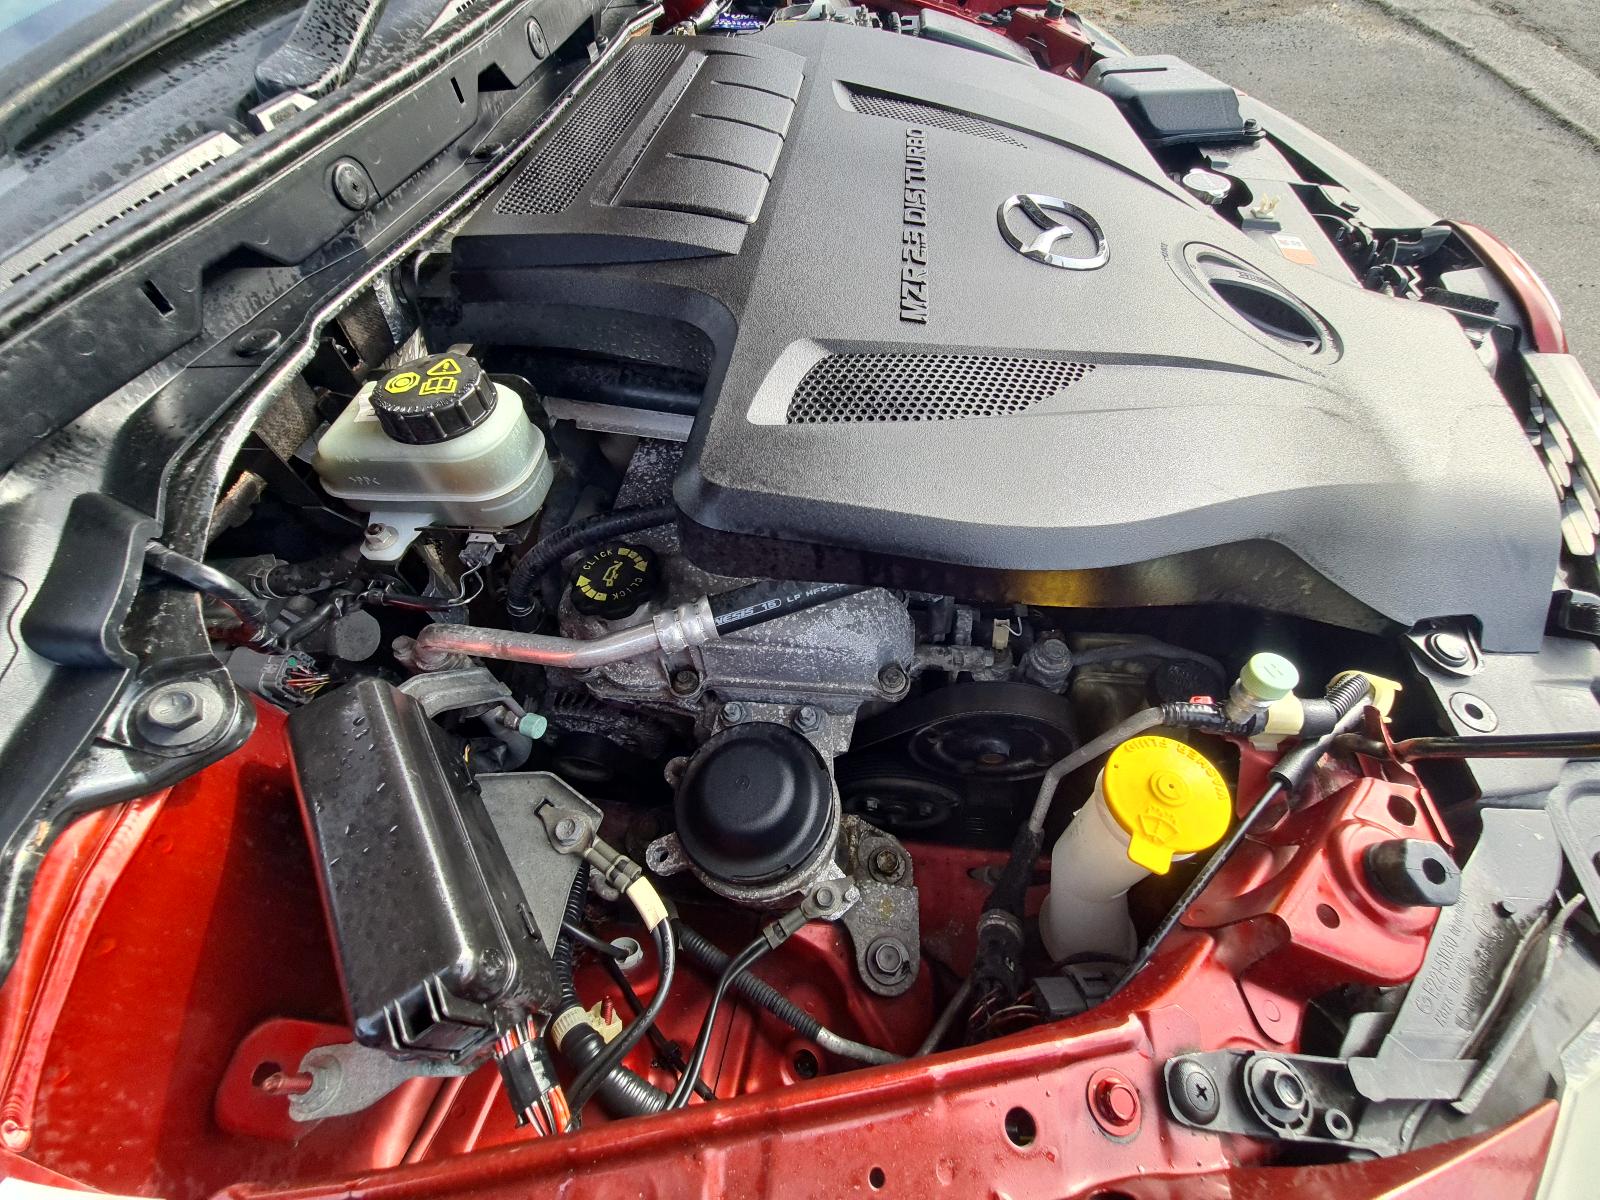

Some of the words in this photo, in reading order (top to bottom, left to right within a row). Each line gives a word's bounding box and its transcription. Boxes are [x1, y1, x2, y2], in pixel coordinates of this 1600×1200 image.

[904, 127, 927, 185] TURBO
[903, 187, 927, 227] DISI
[901, 231, 927, 266] 2.3
[899, 267, 927, 325] MZR
[582, 548, 613, 570] CLICK
[612, 577, 643, 601] CLICK
[786, 594, 801, 603] LP
[1123, 737, 1169, 753] FLUID
[1176, 743, 1228, 801] WASHER
